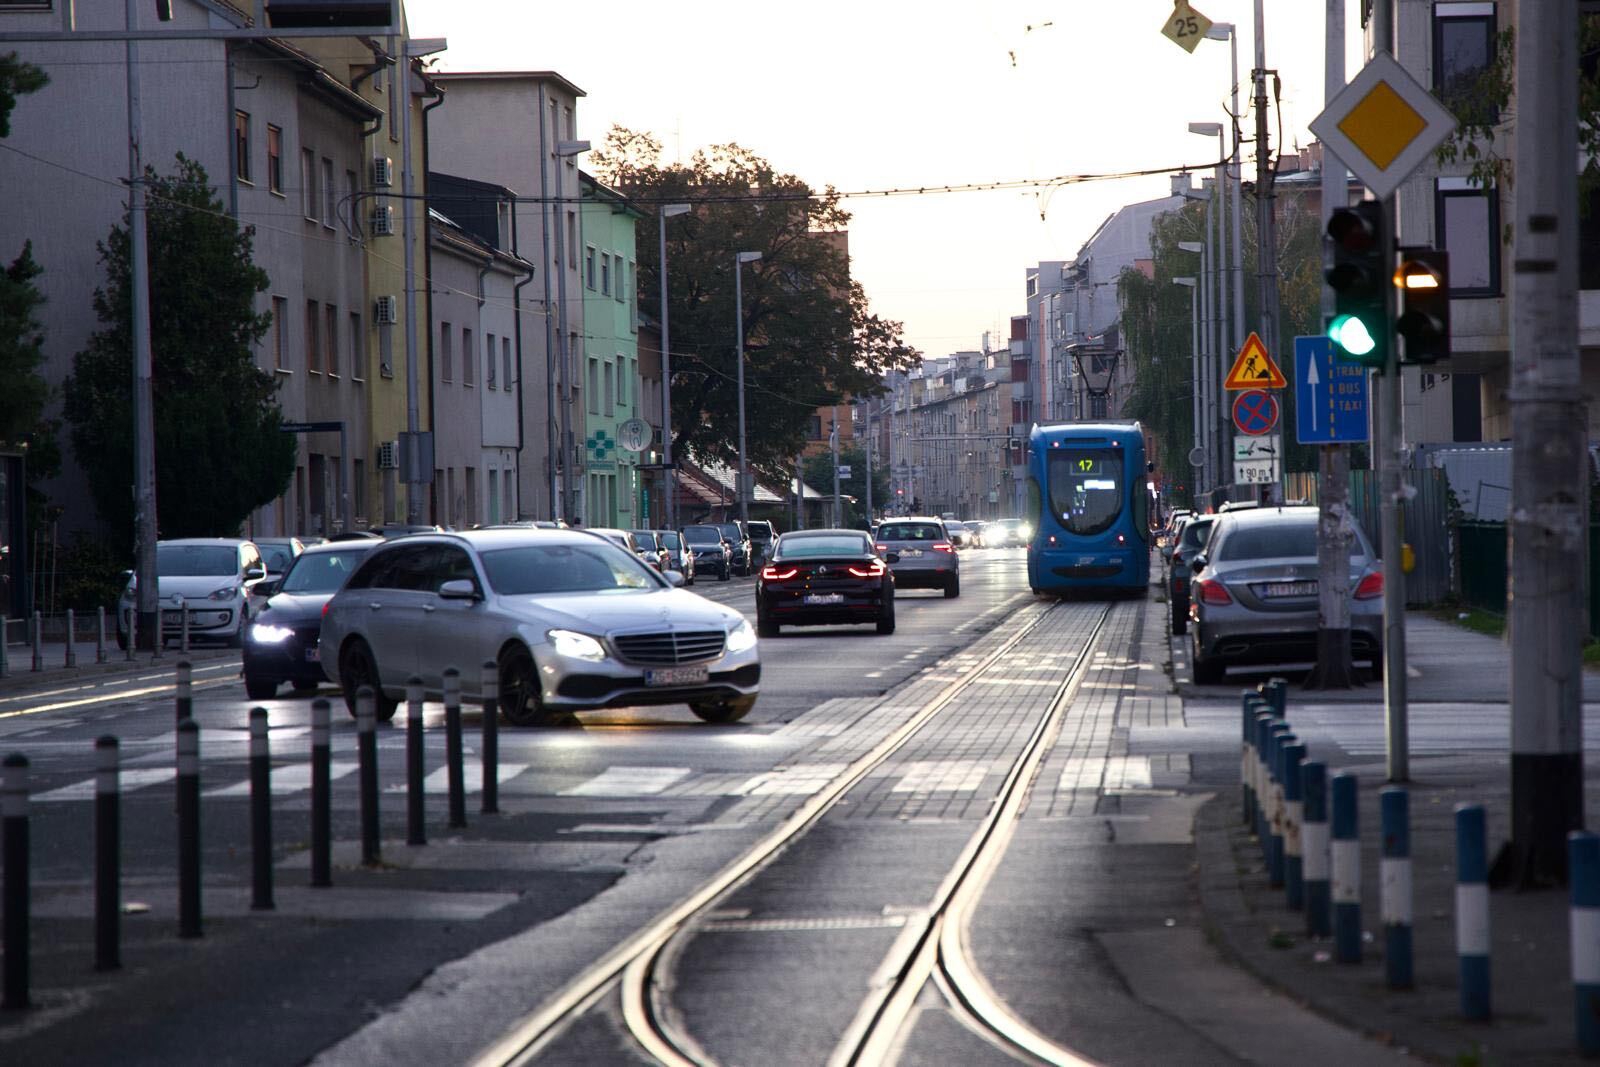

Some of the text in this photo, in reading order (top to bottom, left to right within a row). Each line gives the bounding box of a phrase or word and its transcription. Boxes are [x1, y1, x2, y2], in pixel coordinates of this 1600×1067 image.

[1175, 16, 1199, 38] 25
[1336, 366, 1363, 376] TRAM
[1339, 382, 1361, 394] BUS
[1339, 400, 1362, 411] TAXI
[1079, 460, 1093, 471] 17
[1246, 467, 1257, 479] 90
